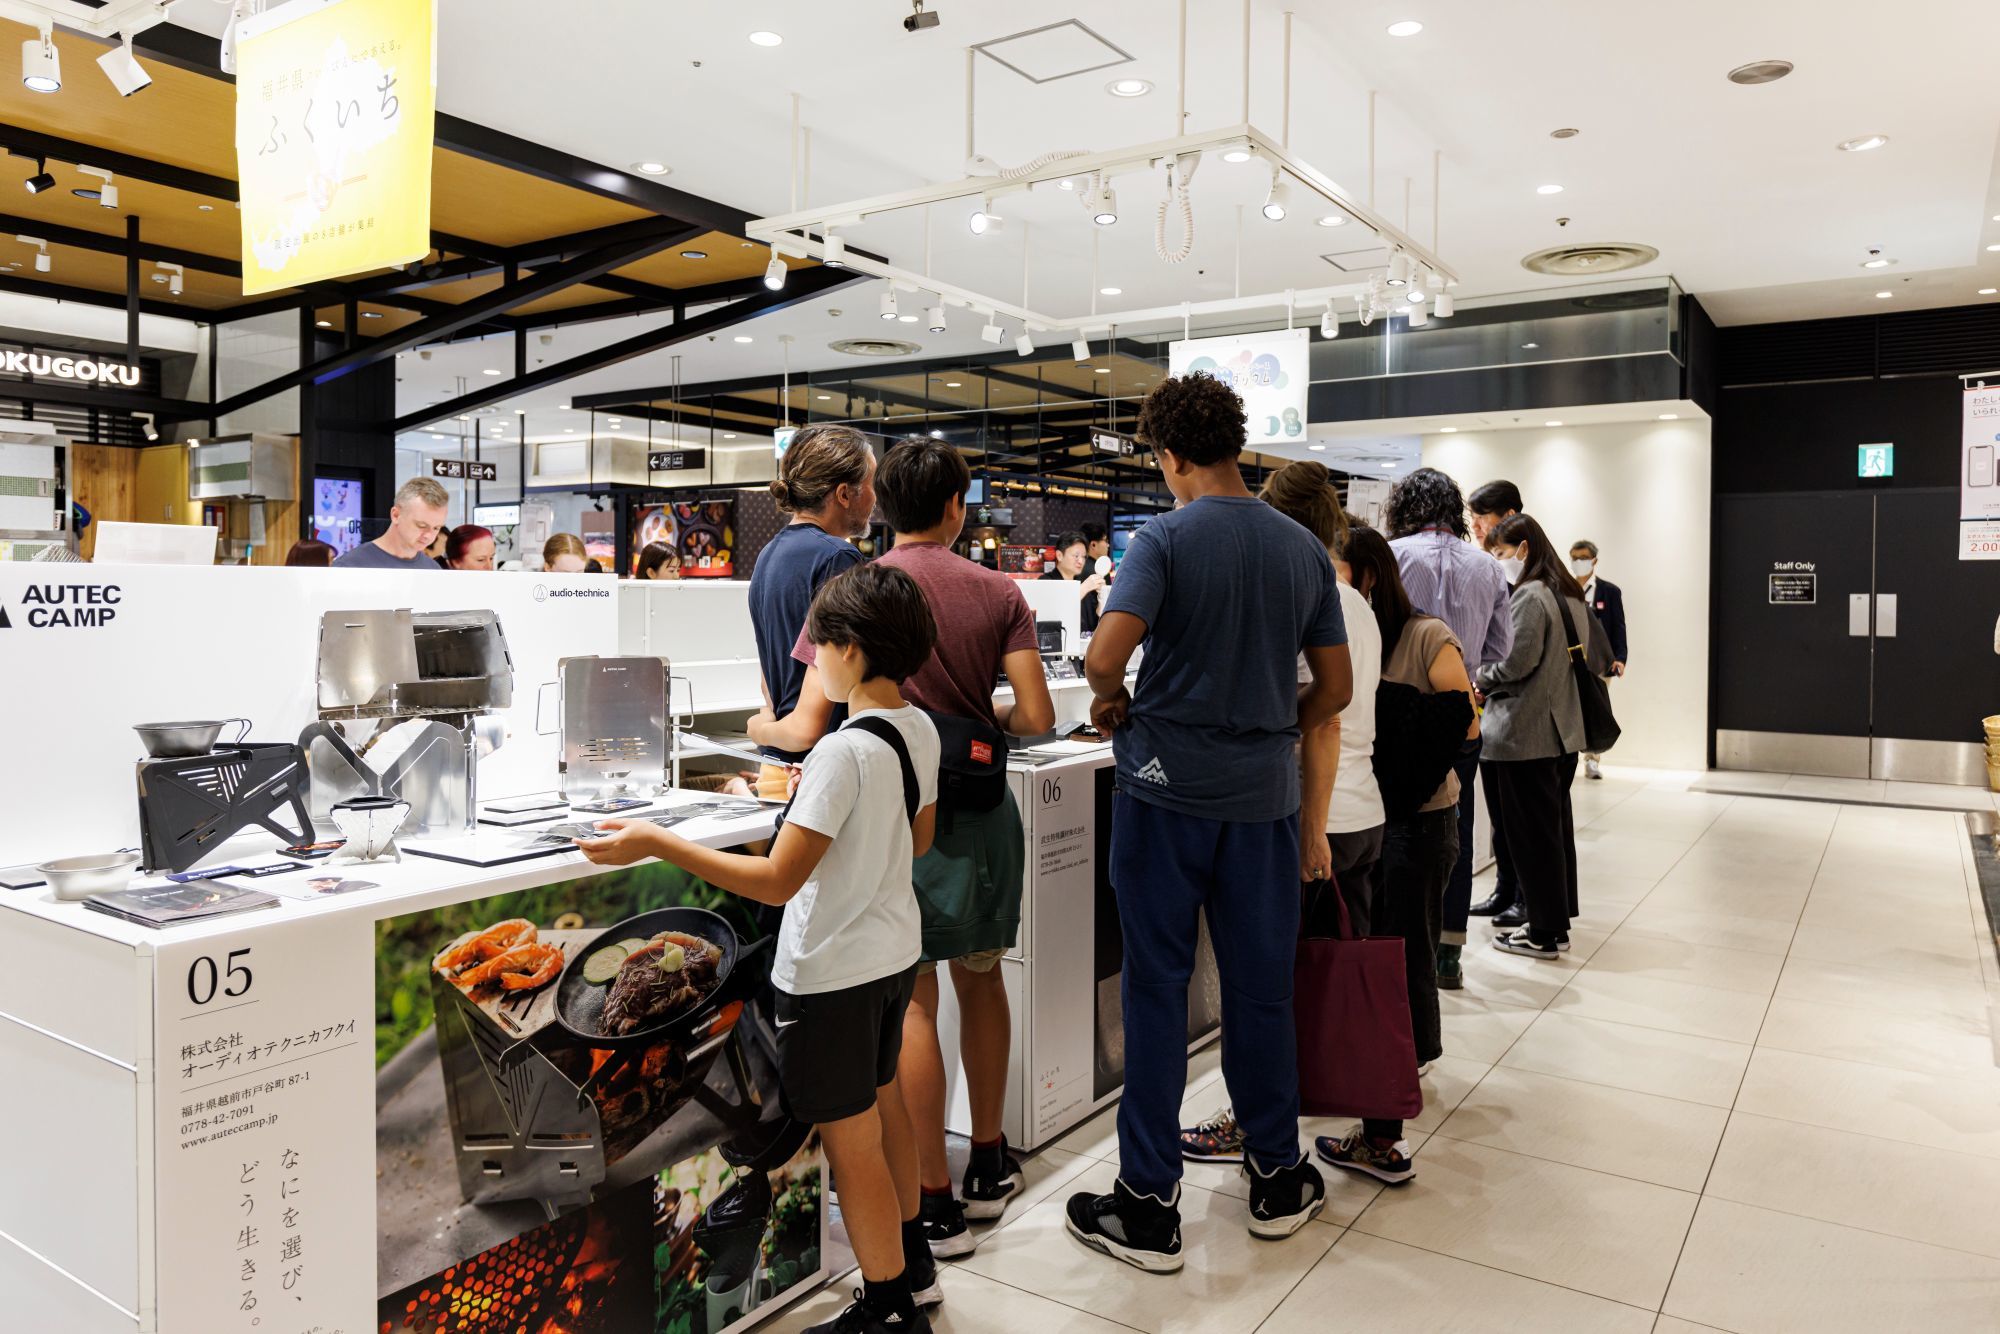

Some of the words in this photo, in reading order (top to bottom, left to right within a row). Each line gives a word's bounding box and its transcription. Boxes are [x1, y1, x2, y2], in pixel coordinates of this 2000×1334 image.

[258, 73, 400, 156] ふくいち
[0, 350, 140, 386] KUGOKU
[1973, 396, 2000, 405] わたし
[1973, 408, 2000, 416] いられ
[1970, 542, 2000, 552] 2,00
[1774, 561, 1794, 570] Staff
[1795, 561, 1815, 571] Only
[21, 584, 121, 604] AUTEC
[549, 588, 610, 598] audio-technica
[28, 607, 116, 628] CAMP
[1042, 776, 1061, 804] 06
[187, 947, 253, 1005] 05
[180, 1032, 244, 1061] 株式会社
[181, 1018, 356, 1079] オーディオテクニカフクイ
[181, 1078, 285, 1118] 福井県越前市戸谷町
[288, 1071, 311, 1086] 87-1
[180, 1104, 254, 1135] 0778-42-7091
[180, 1113, 279, 1150] www.auteccamp.jp
[280, 1148, 304, 1302] なにを選び、
[235, 1160, 261, 1327] どう生きる。
